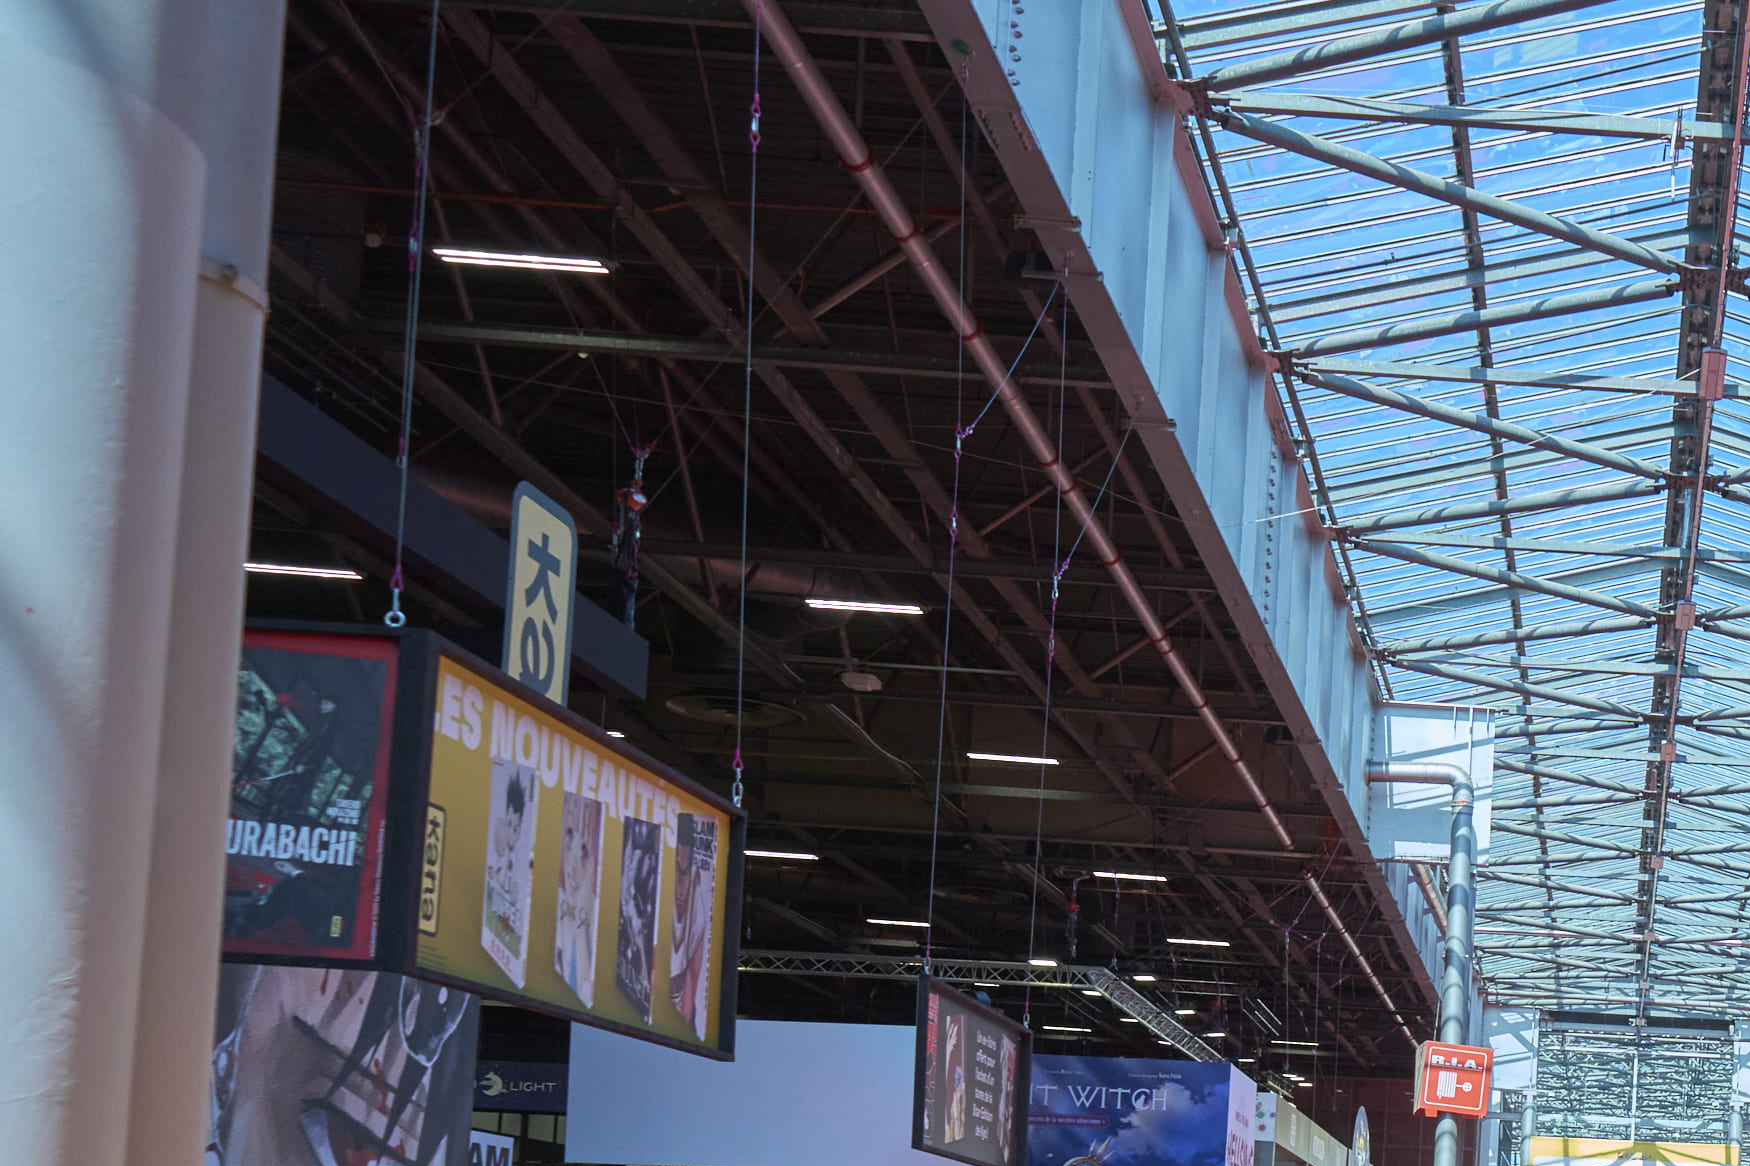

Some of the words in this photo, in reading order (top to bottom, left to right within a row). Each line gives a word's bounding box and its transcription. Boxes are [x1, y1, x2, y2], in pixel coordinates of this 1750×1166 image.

[435, 673, 483, 750] ES
[490, 699, 682, 849] NOUVEAUTÉS
[1432, 1054, 1483, 1070] R.I.A.
[510, 1082, 557, 1093] LIGHT
[1067, 1085, 1168, 1112] WITCH
